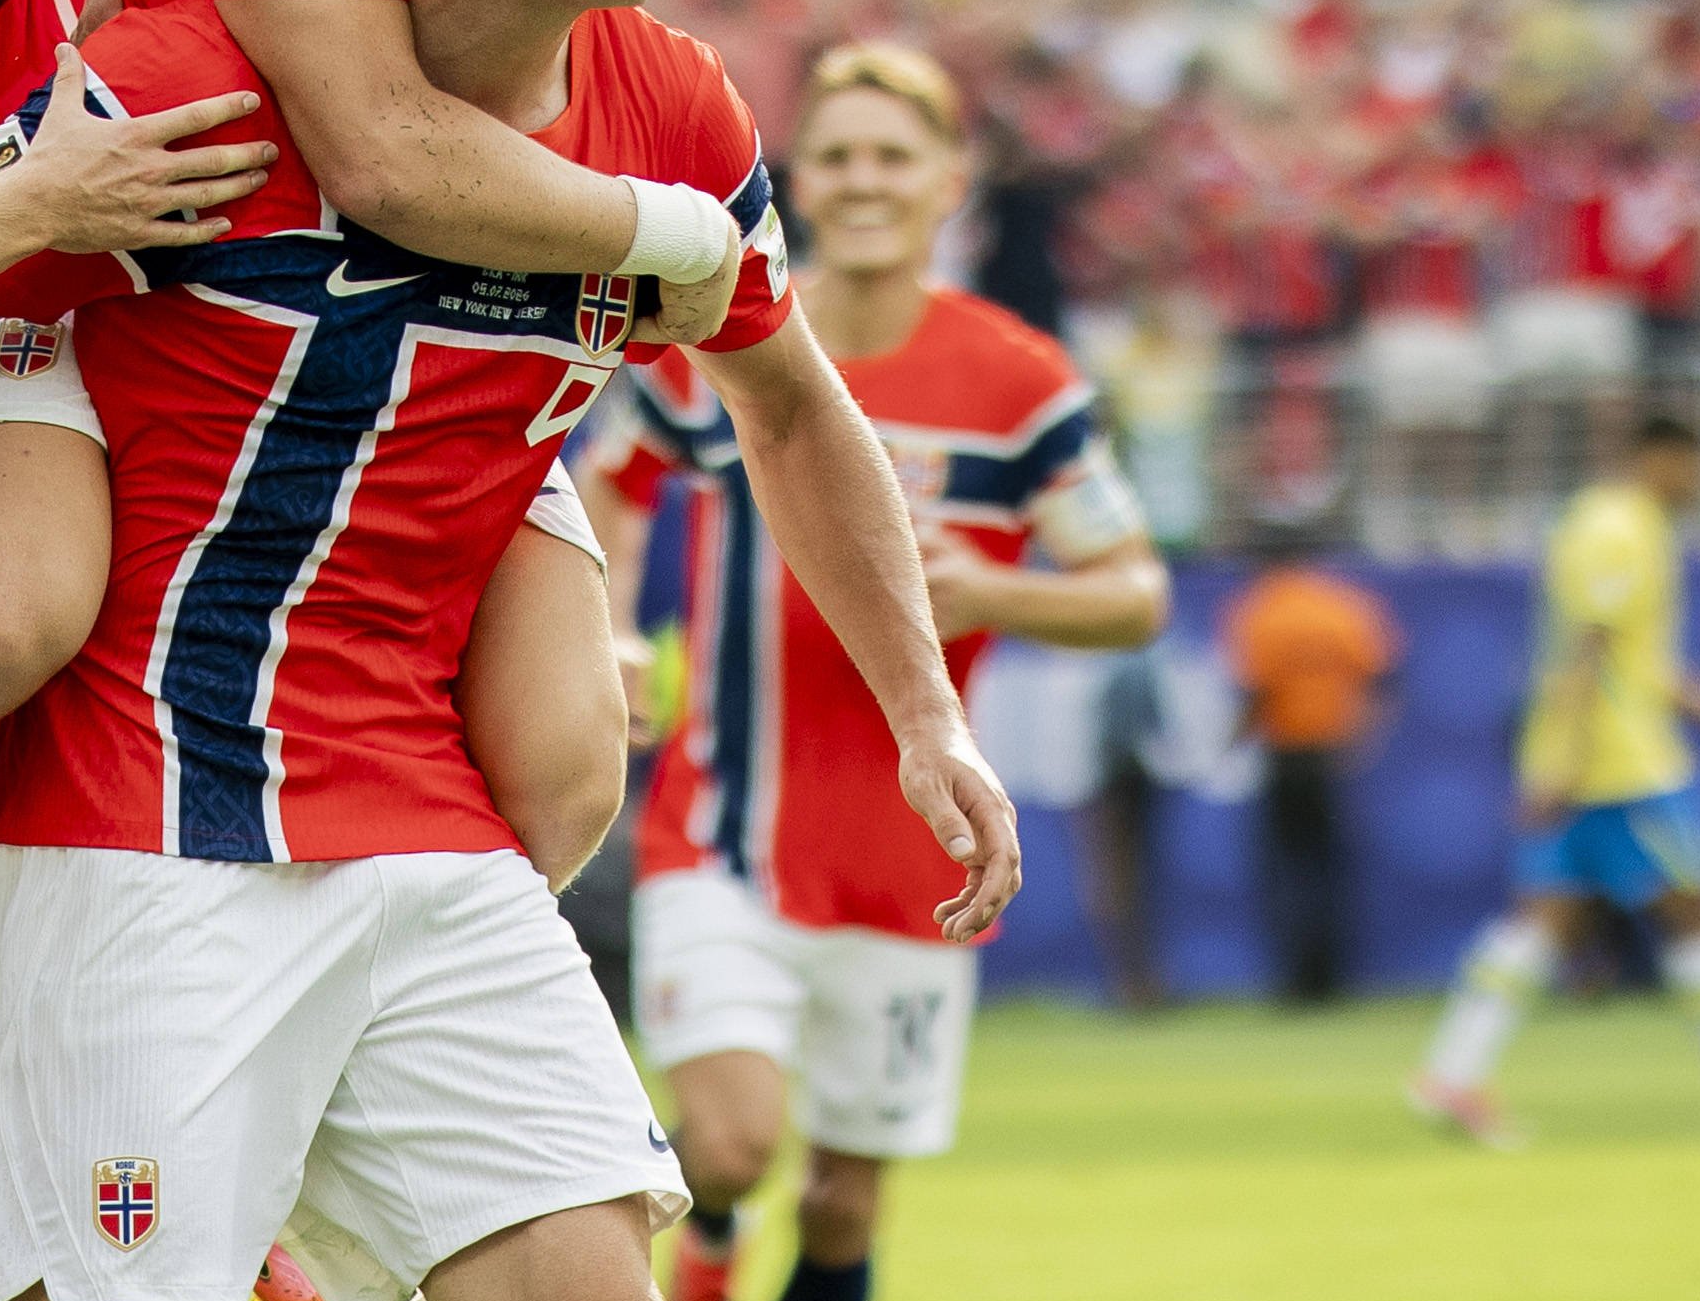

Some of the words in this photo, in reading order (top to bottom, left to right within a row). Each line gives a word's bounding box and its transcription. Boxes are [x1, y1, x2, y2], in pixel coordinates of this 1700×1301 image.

[471, 282, 531, 302] 05.07.2026
[438, 295, 464, 311] NEW
[464, 299, 491, 317] YORK
[489, 305, 513, 320] NEW
